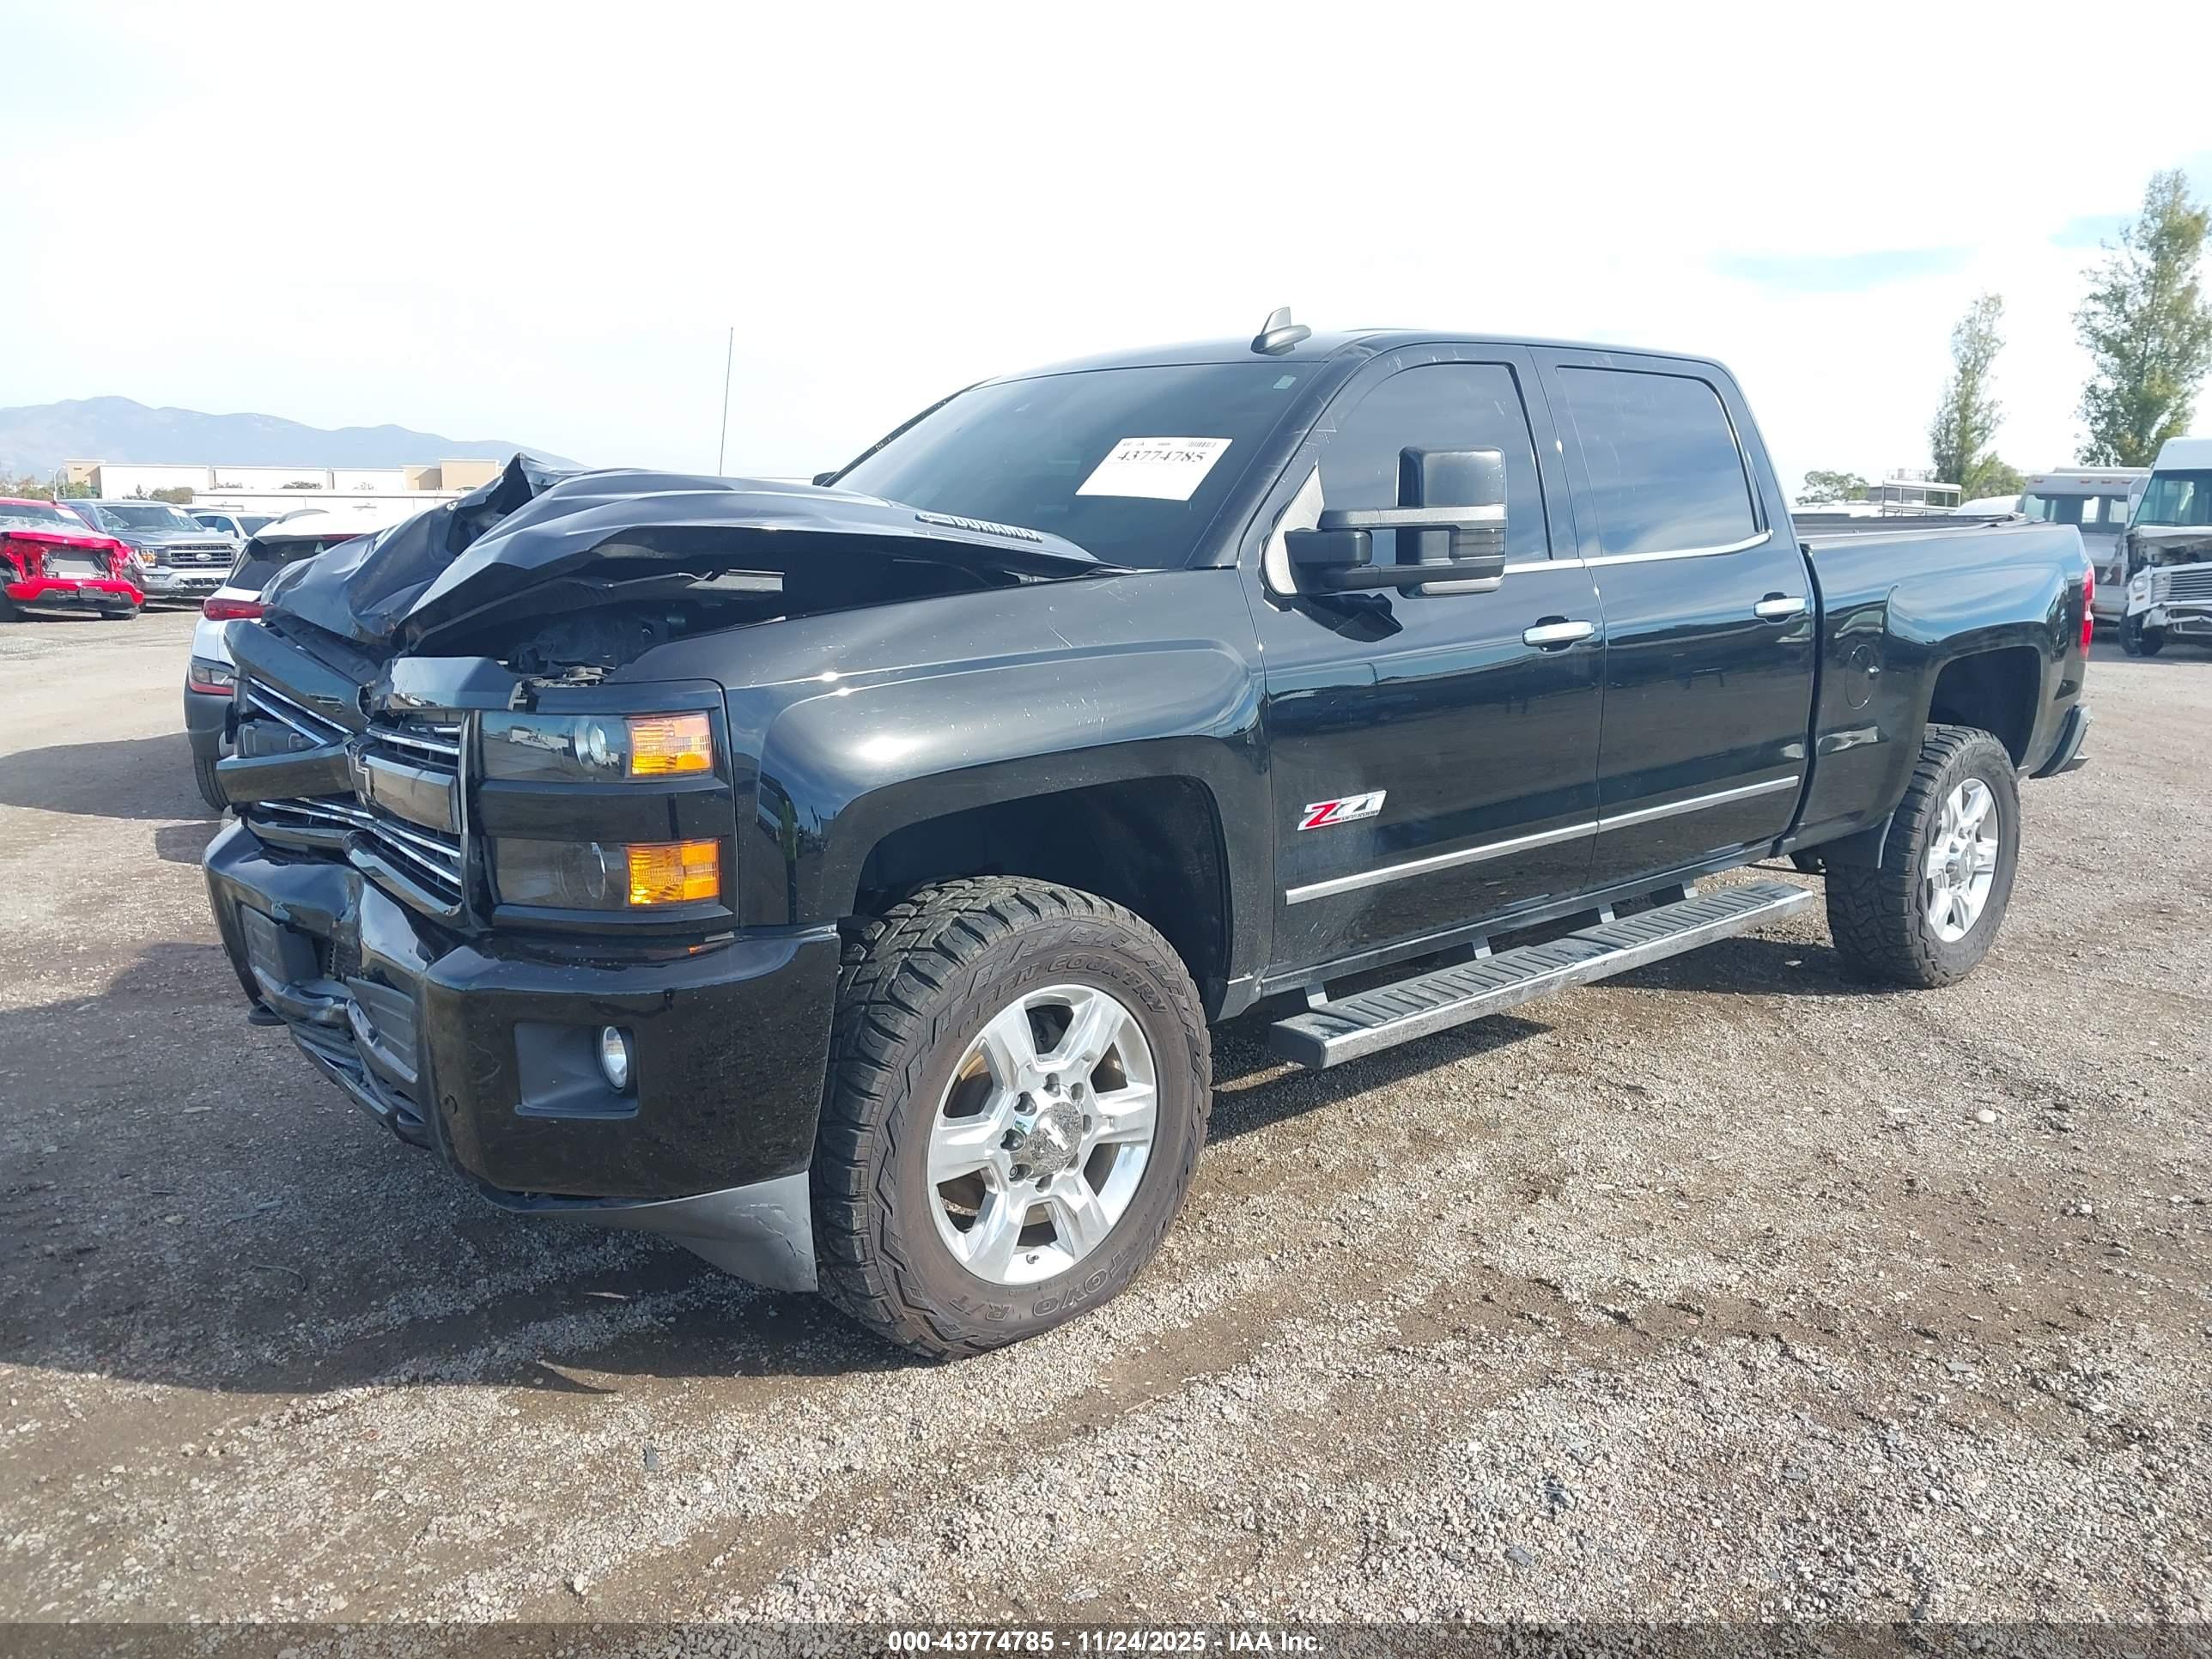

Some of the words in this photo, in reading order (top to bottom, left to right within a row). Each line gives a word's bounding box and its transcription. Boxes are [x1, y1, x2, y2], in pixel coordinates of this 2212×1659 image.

[1117, 450, 1206, 463] 43774785
[948, 516, 1043, 544] DURAMAX
[1297, 790, 1387, 831] Z71
[1048, 952, 1168, 1012] COUNTRY
[1032, 1250, 1127, 1317] TOYO
